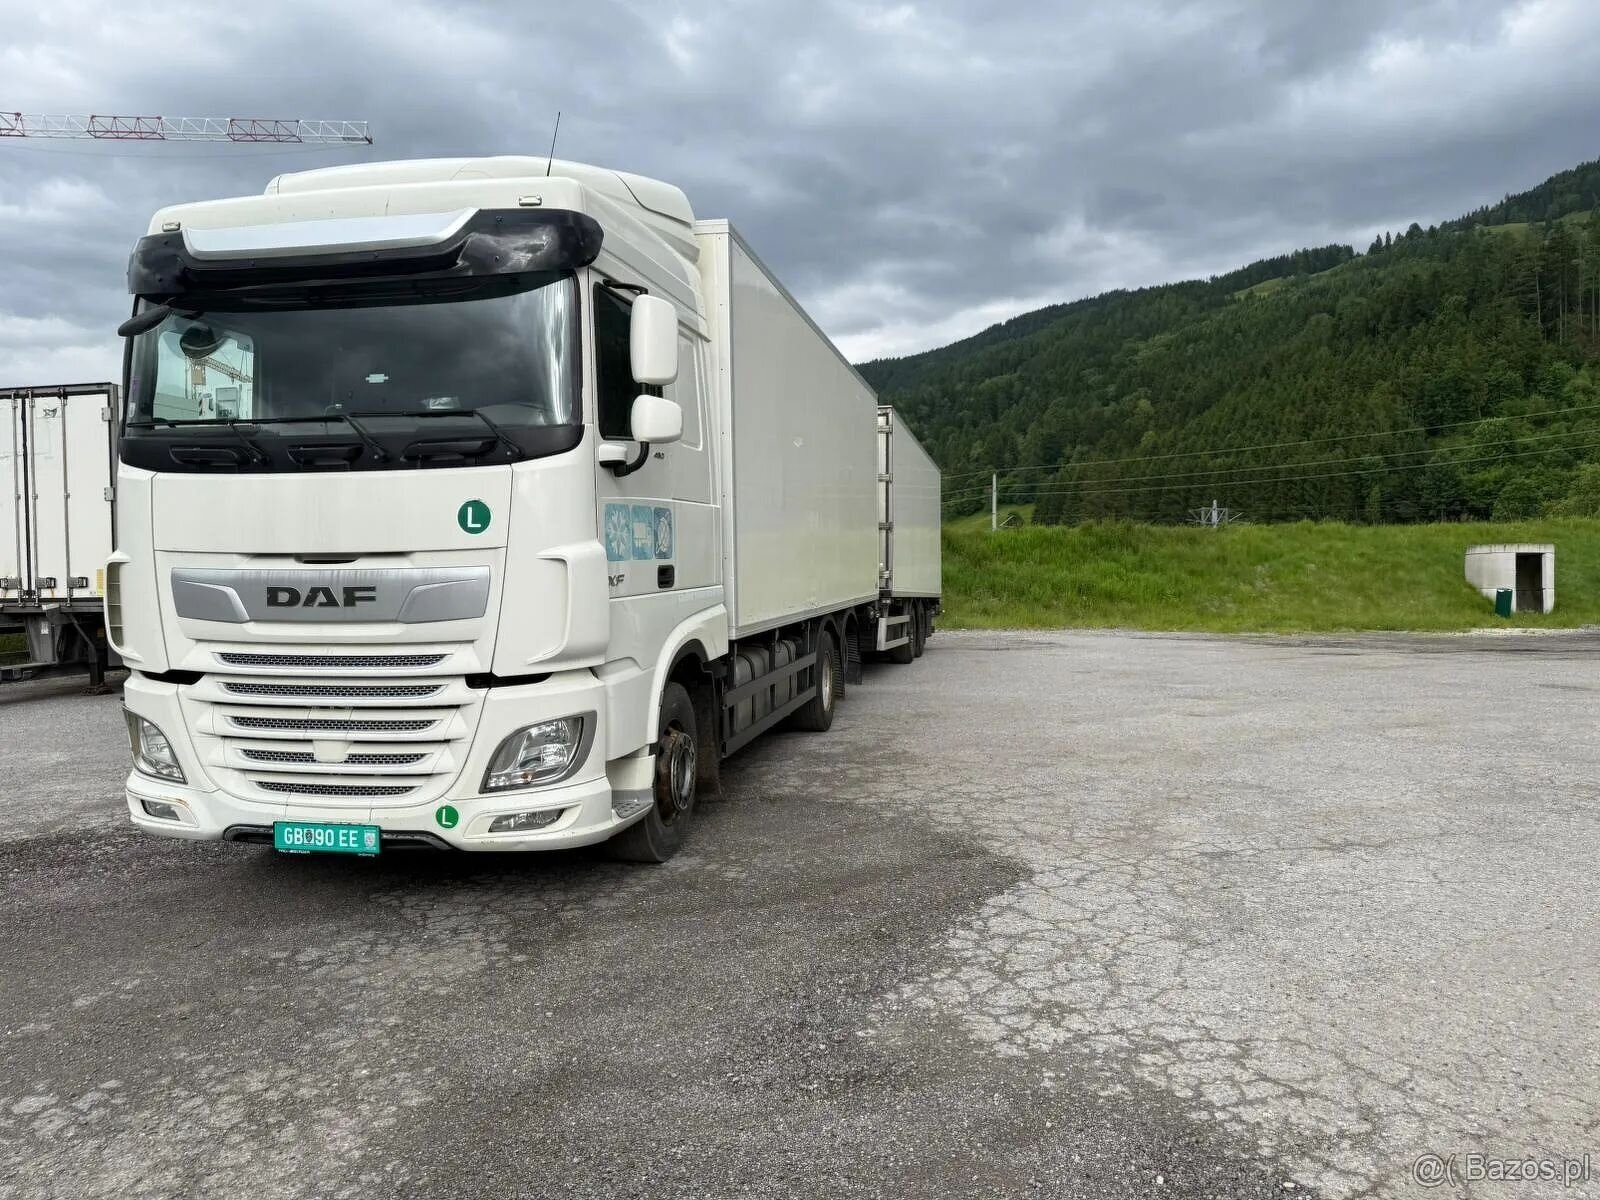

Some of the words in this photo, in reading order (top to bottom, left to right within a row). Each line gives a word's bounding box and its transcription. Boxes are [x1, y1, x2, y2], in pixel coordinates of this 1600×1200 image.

[467, 506, 482, 528] L
[266, 585, 377, 608] DAF
[441, 808, 453, 826] L
[284, 827, 303, 845] GB
[339, 829, 360, 848] EE
